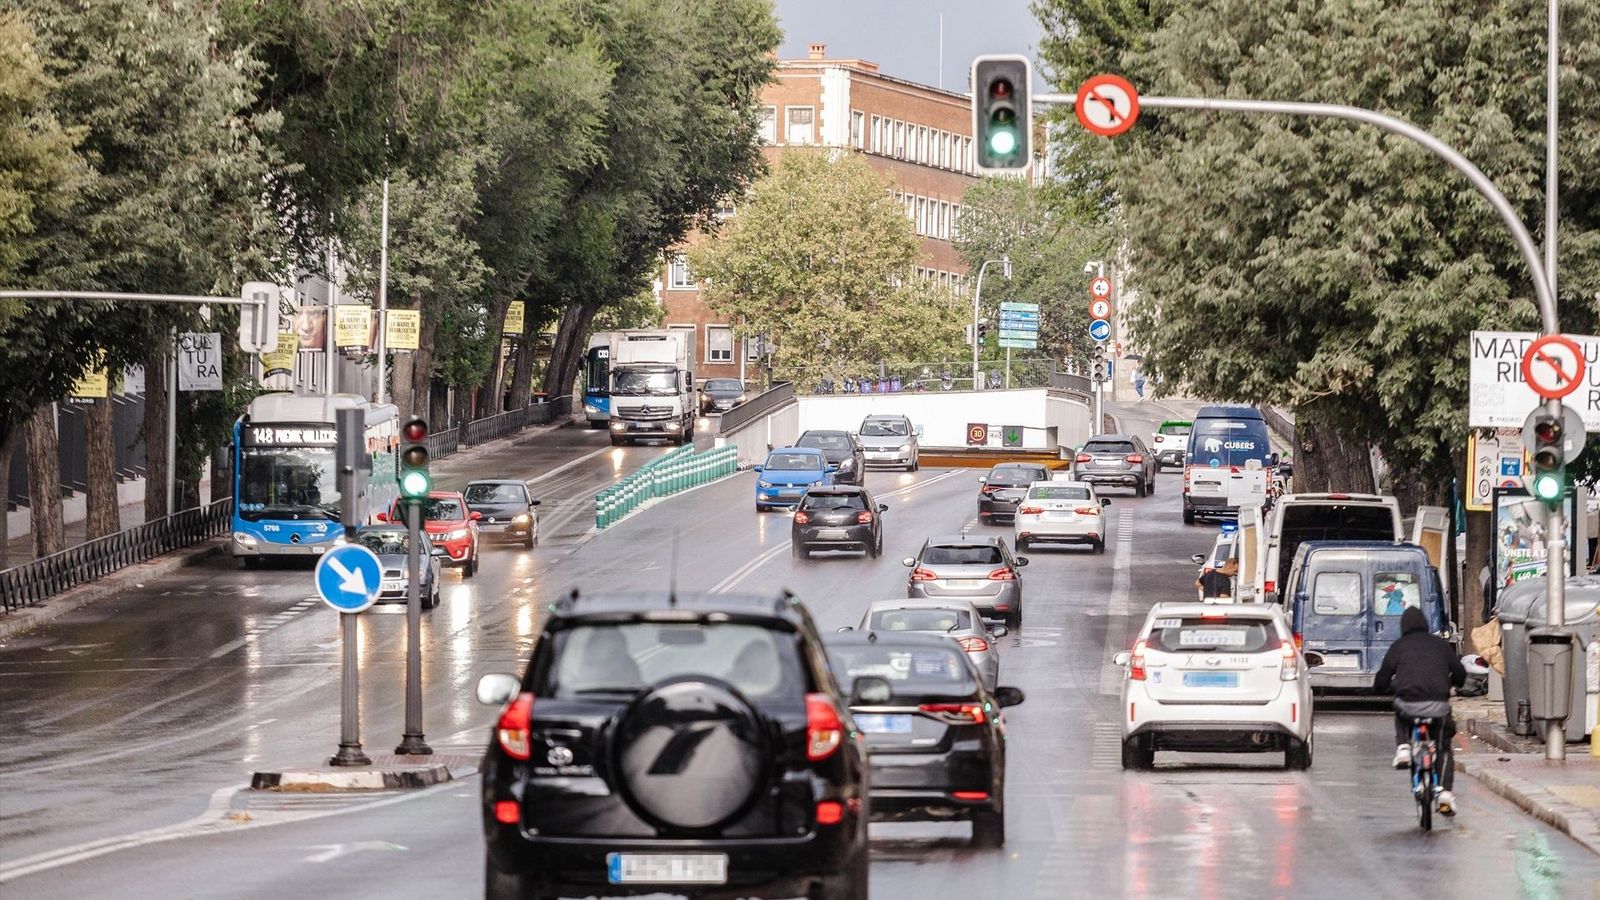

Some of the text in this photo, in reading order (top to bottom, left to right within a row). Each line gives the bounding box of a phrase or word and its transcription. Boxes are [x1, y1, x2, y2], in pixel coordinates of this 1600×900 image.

[185, 350, 207, 364] TU
[197, 365, 219, 378] RA
[253, 428, 273, 443] 148
[1224, 441, 1254, 450] CUBERS
